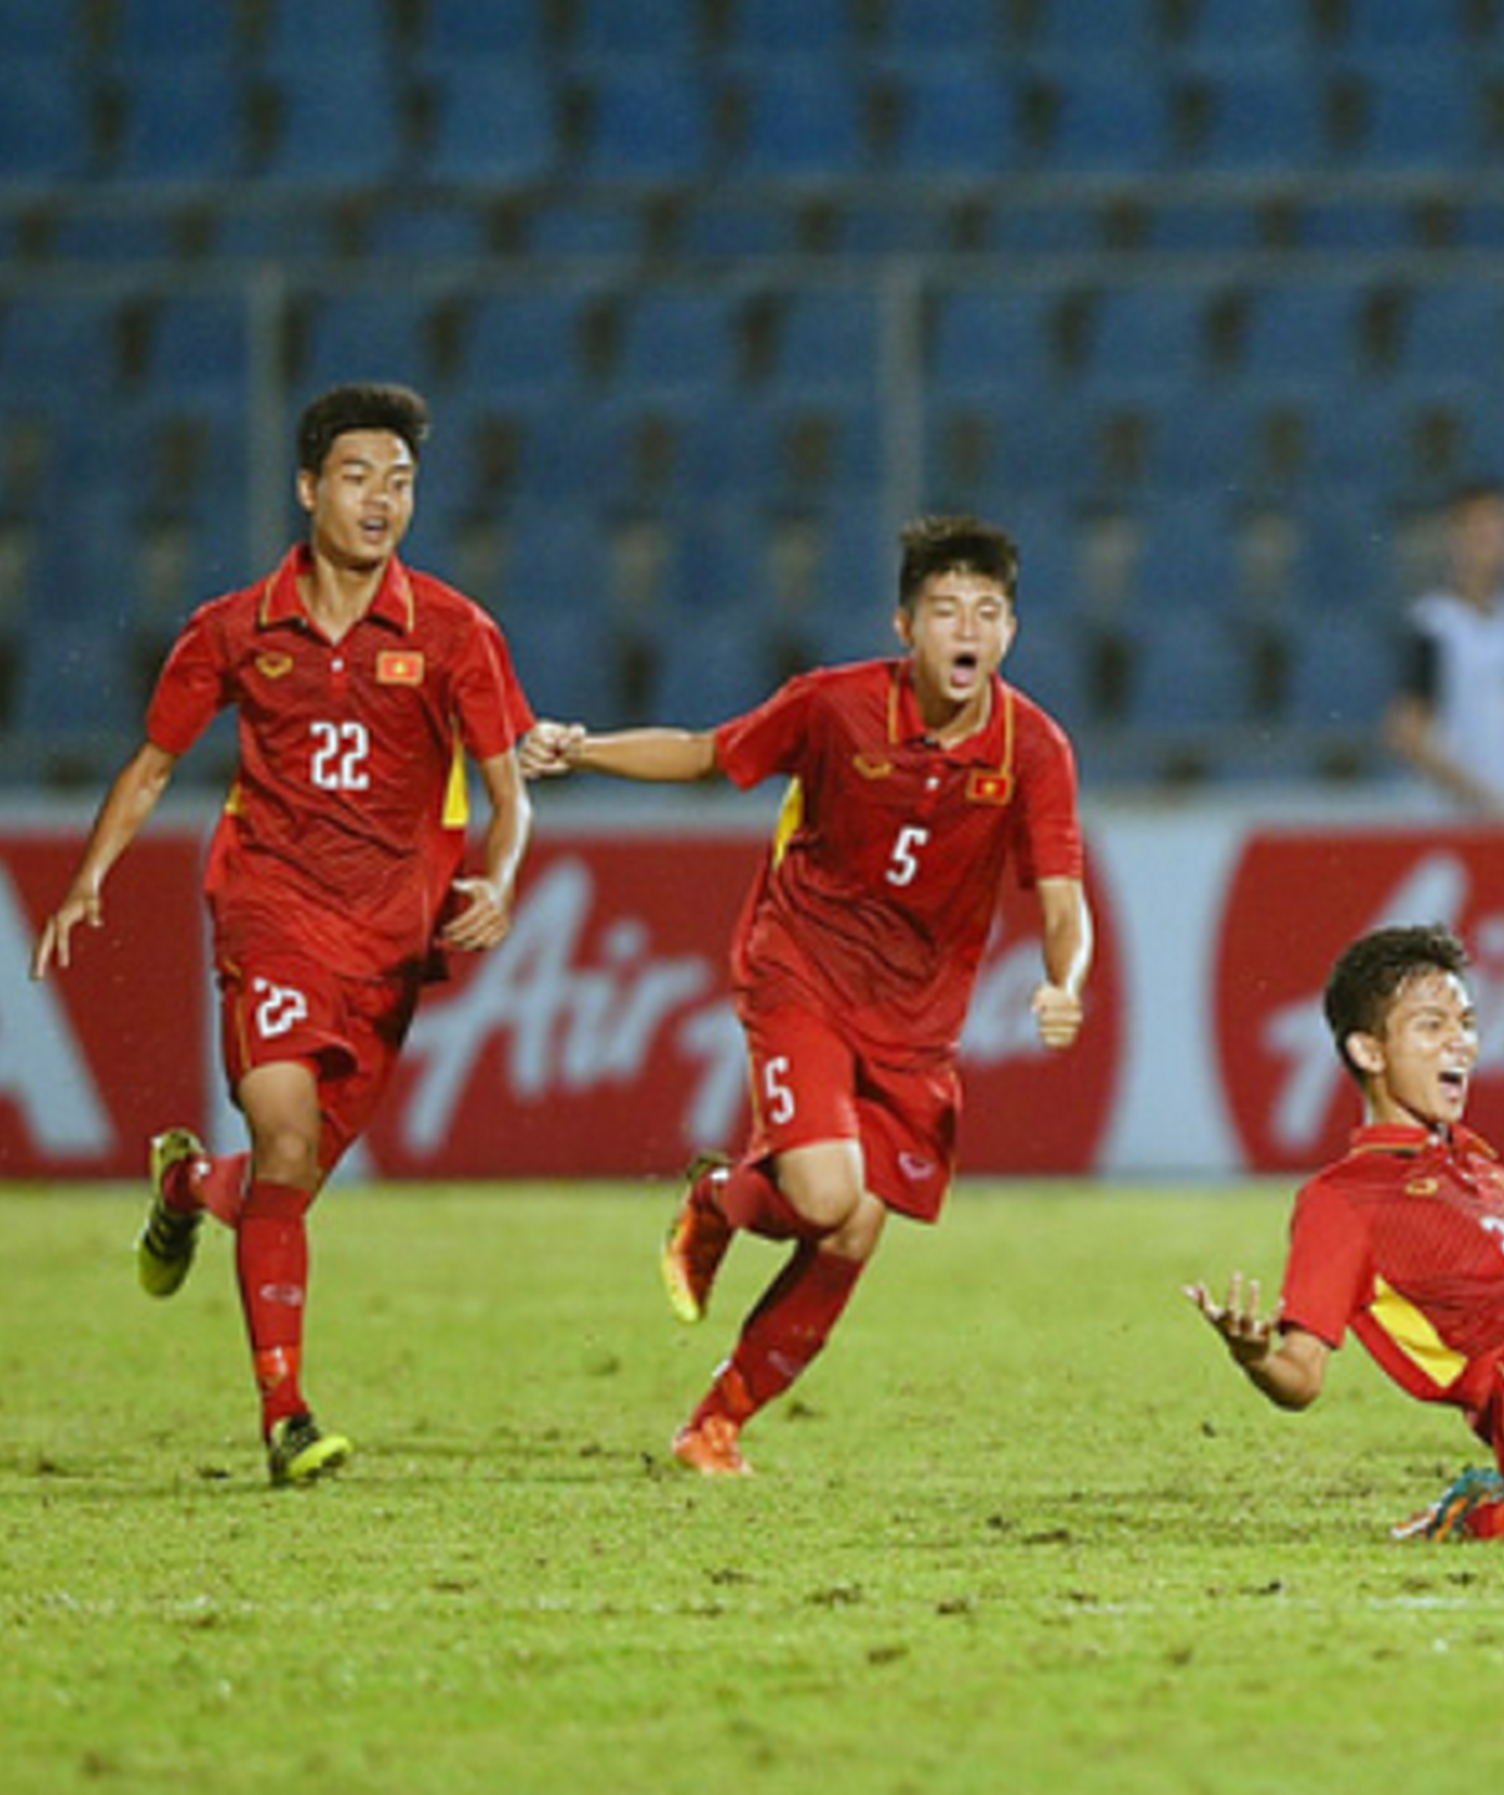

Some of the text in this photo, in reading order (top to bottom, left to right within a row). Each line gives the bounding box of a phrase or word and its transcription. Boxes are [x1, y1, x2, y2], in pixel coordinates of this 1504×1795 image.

[309, 721, 369, 790] 22
[886, 826, 928, 885] 5
[252, 976, 308, 1038] 22
[764, 1056, 794, 1124] 5
